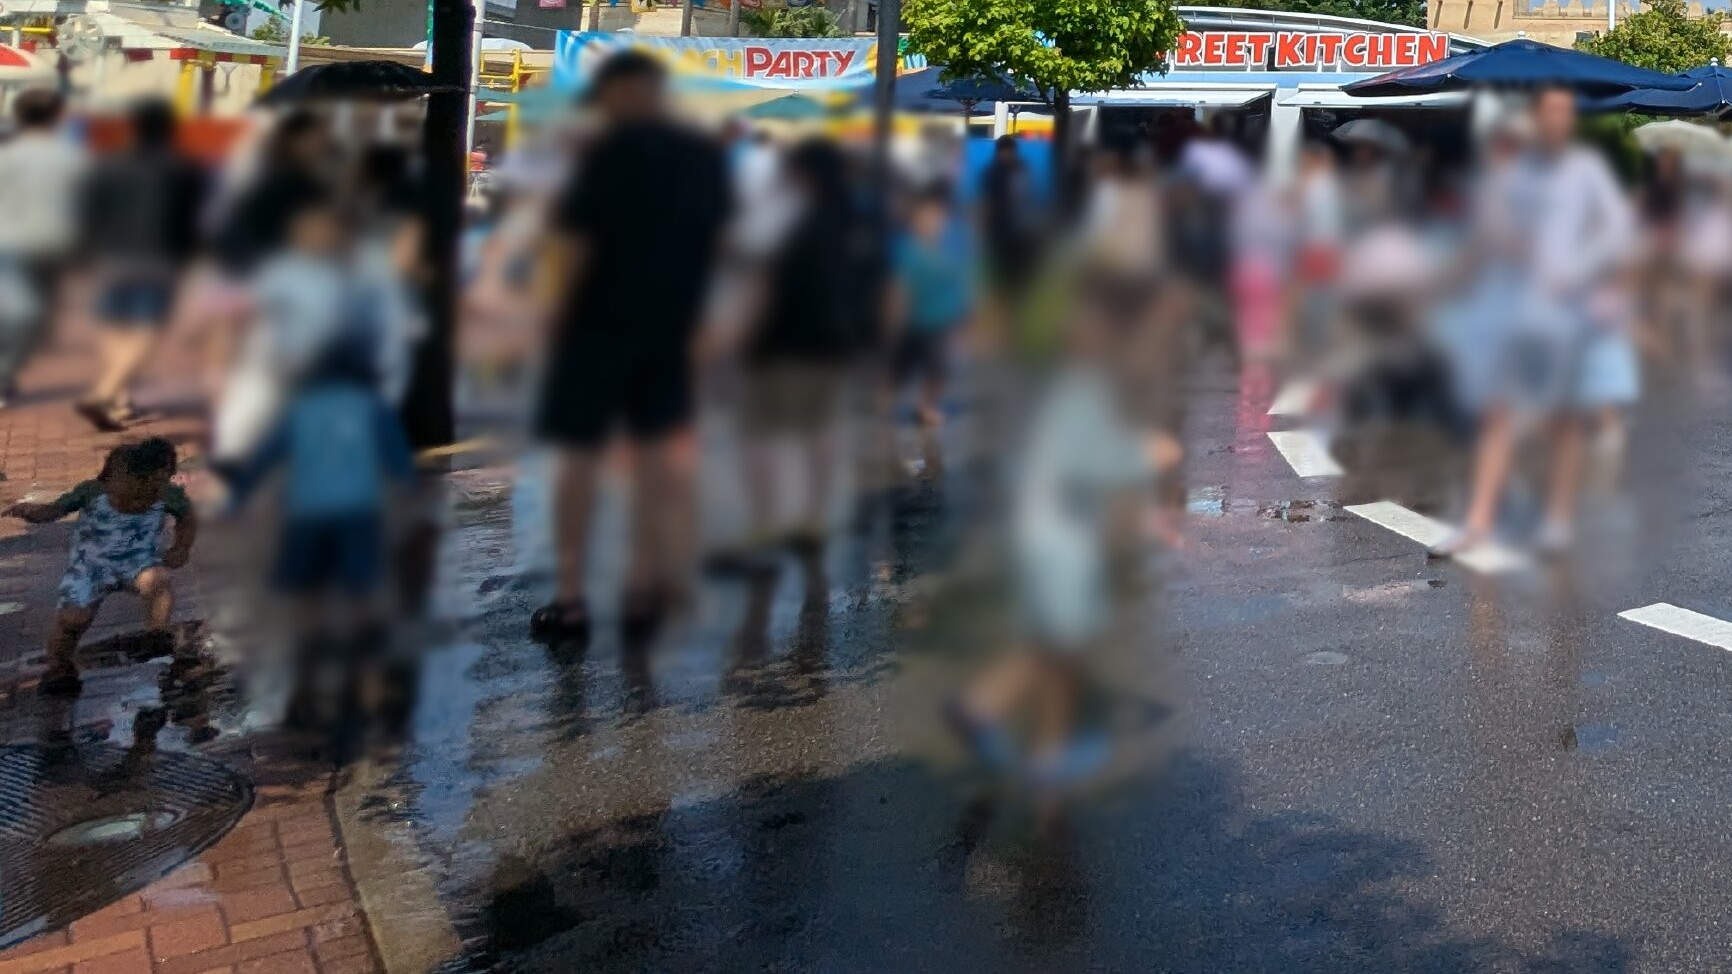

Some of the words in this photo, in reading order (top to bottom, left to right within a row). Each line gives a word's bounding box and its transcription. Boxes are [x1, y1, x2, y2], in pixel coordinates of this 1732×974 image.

[744, 46, 856, 79] PARTY
[1154, 31, 1273, 65] REET
[1275, 31, 1449, 67] KITCHEN
